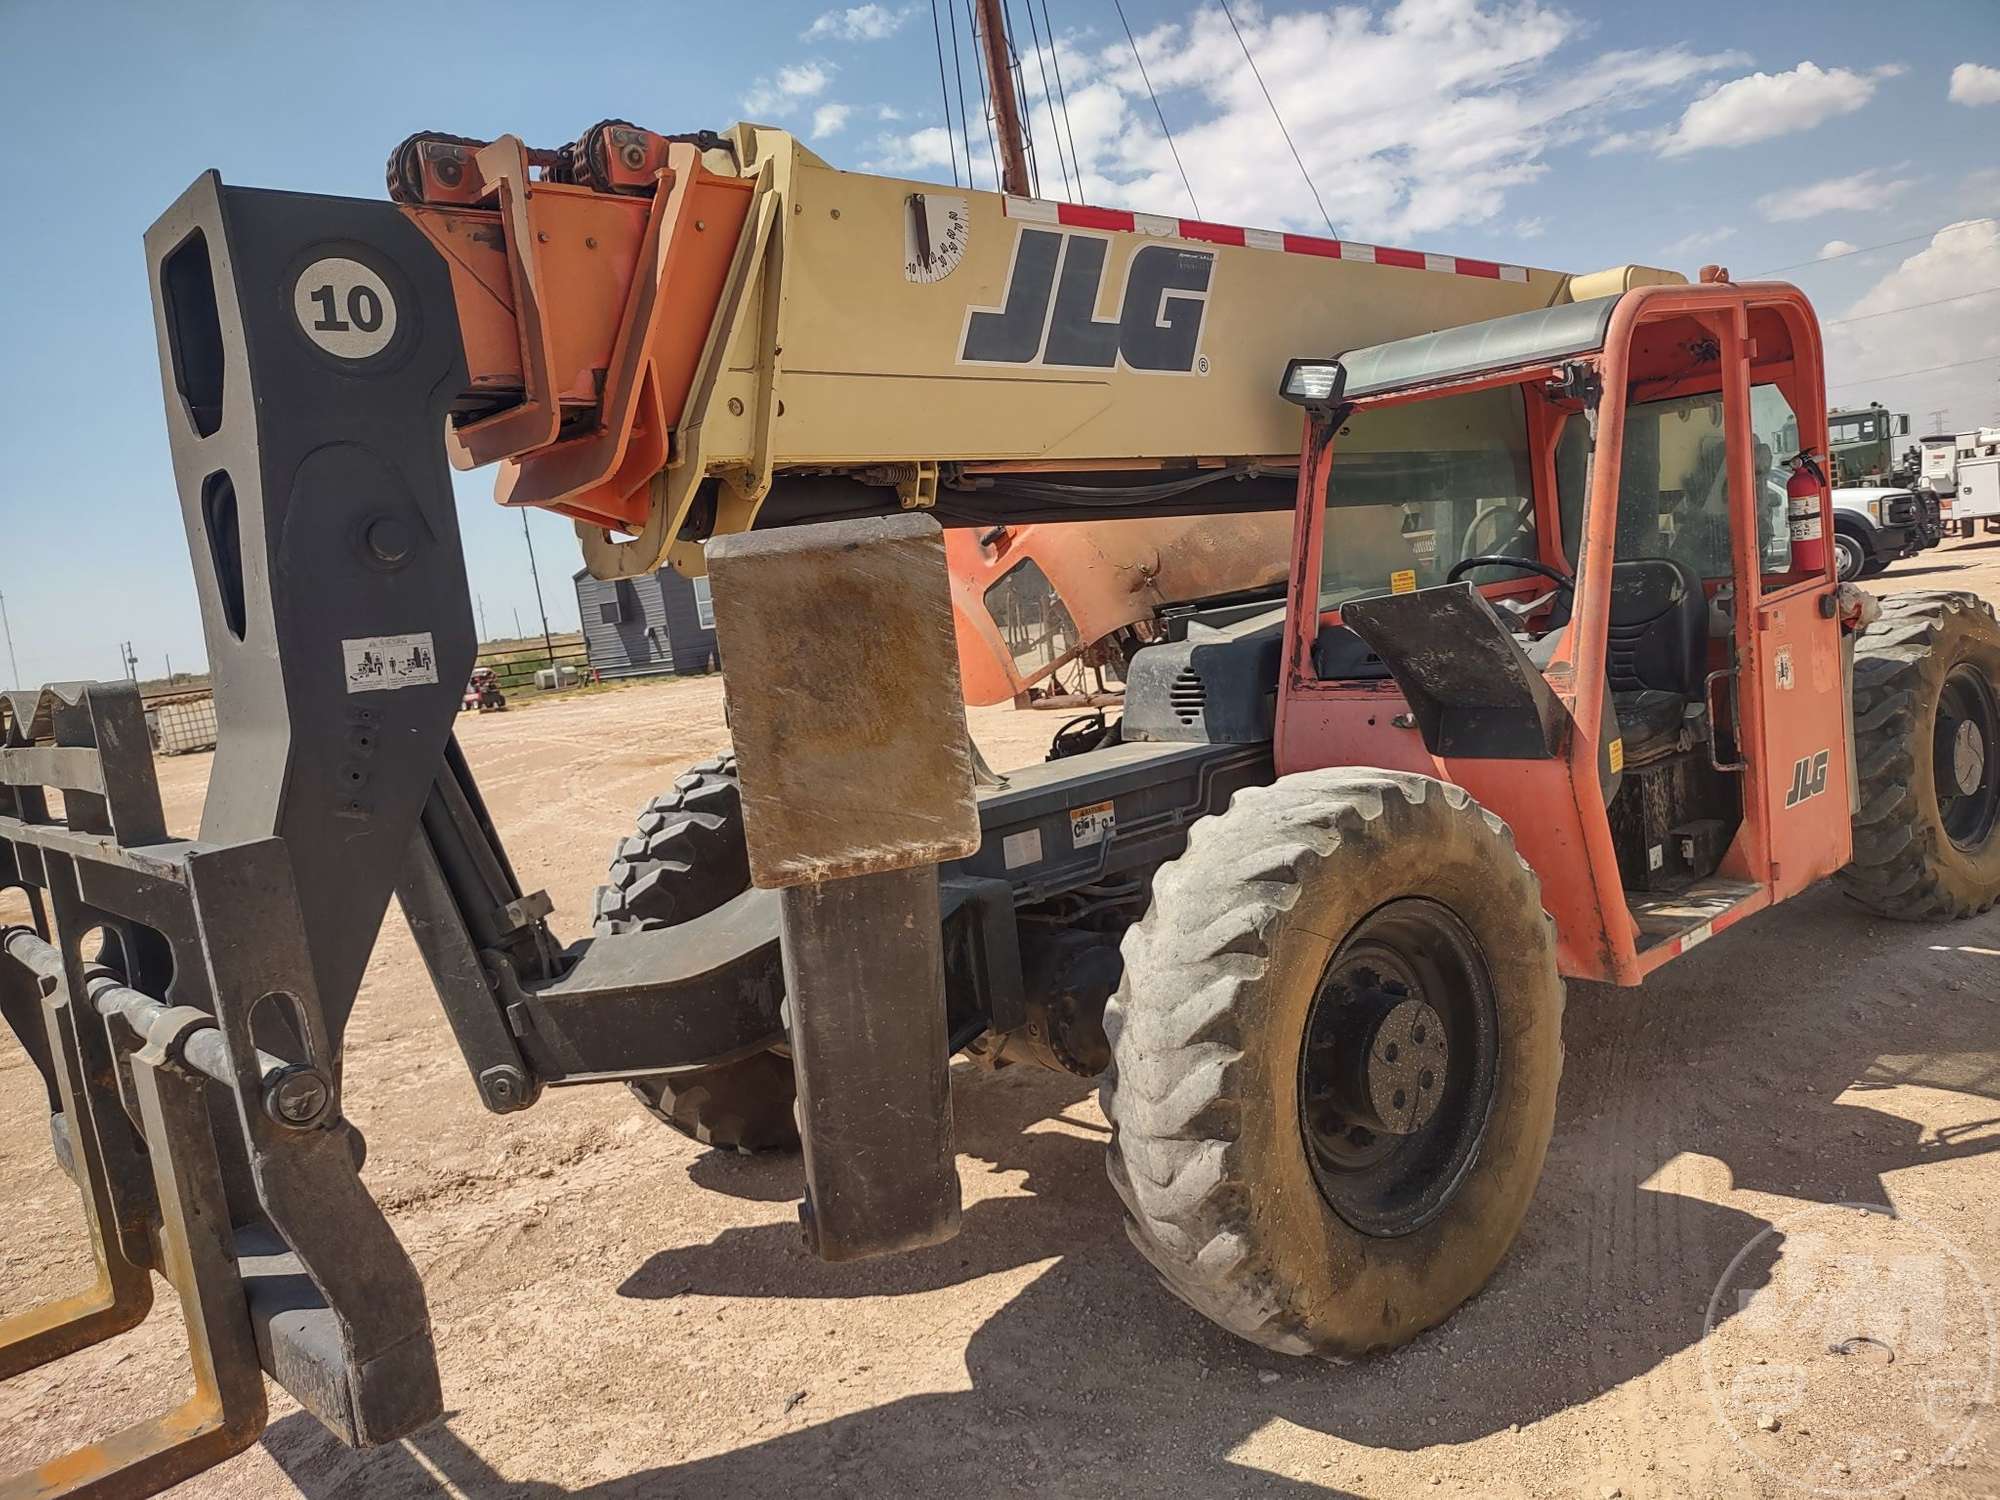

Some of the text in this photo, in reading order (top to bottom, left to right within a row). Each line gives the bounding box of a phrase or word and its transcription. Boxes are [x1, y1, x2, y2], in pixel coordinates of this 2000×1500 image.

[310, 285, 383, 333] 10
[958, 225, 1217, 373] JLG
[1785, 748, 1830, 809] JLG
